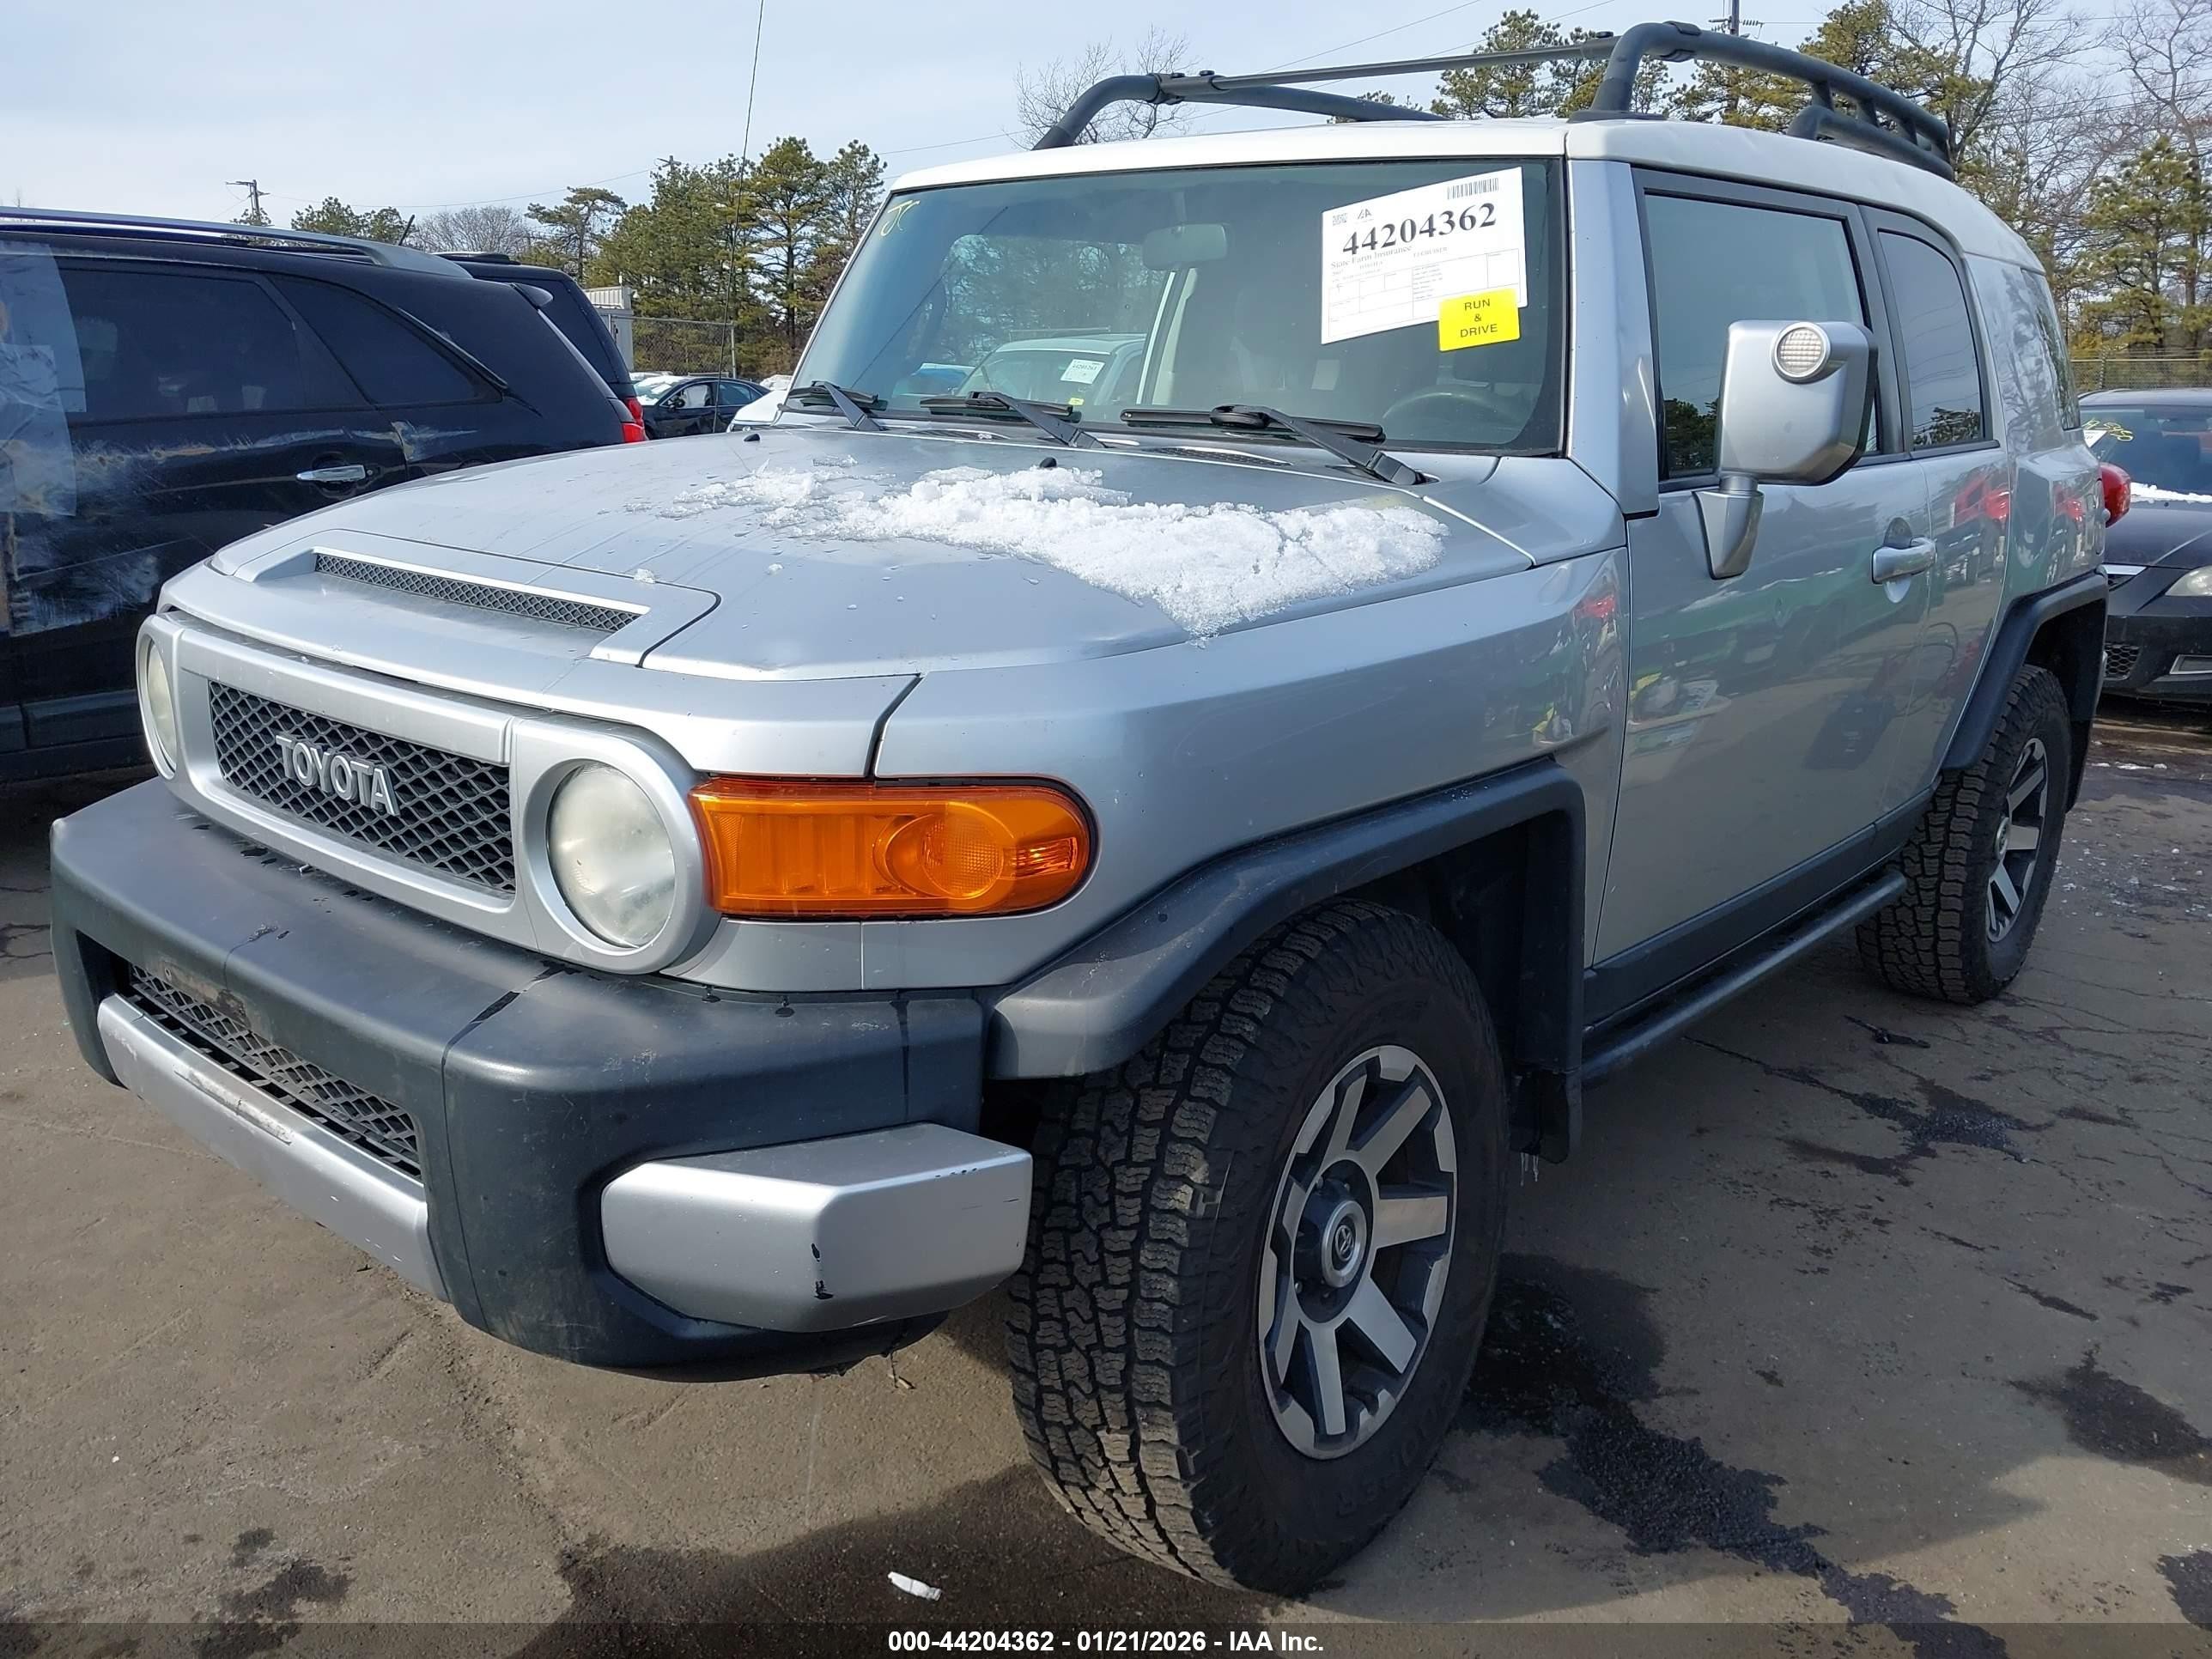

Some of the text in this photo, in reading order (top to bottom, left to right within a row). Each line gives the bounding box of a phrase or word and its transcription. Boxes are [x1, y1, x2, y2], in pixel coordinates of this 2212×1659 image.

[1342, 202, 1497, 255] 44204362
[1331, 260, 1350, 270] State
[1352, 253, 1373, 264] Farm
[1374, 245, 1413, 260] Insurance
[1463, 298, 1491, 311] RUN
[1474, 313, 1483, 323] &
[1460, 323, 1498, 338] DRIVE
[276, 735, 400, 816] TOYOTA
